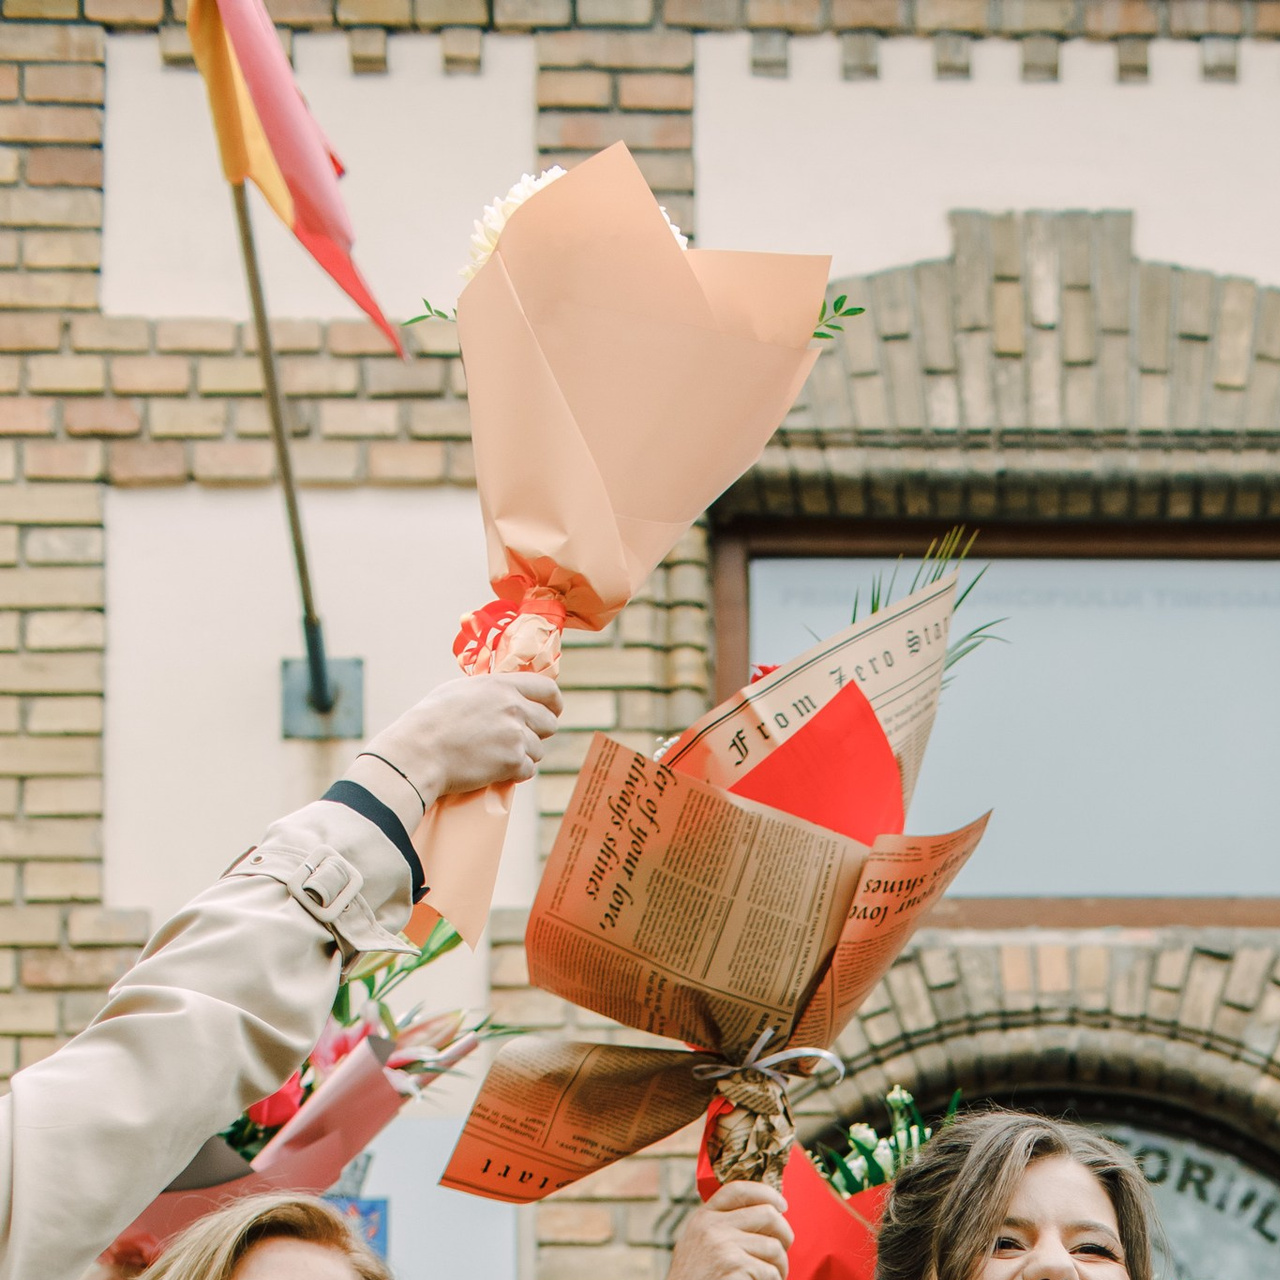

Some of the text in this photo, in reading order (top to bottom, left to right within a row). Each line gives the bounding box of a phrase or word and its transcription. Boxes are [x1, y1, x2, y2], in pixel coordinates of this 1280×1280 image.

[727, 691, 818, 766] From
[608, 751, 648, 831] always
[637, 794, 660, 832] of
[584, 831, 620, 900] shines
[621, 818, 649, 880] your
[599, 881, 633, 930] love,
[863, 874, 926, 898] shines
